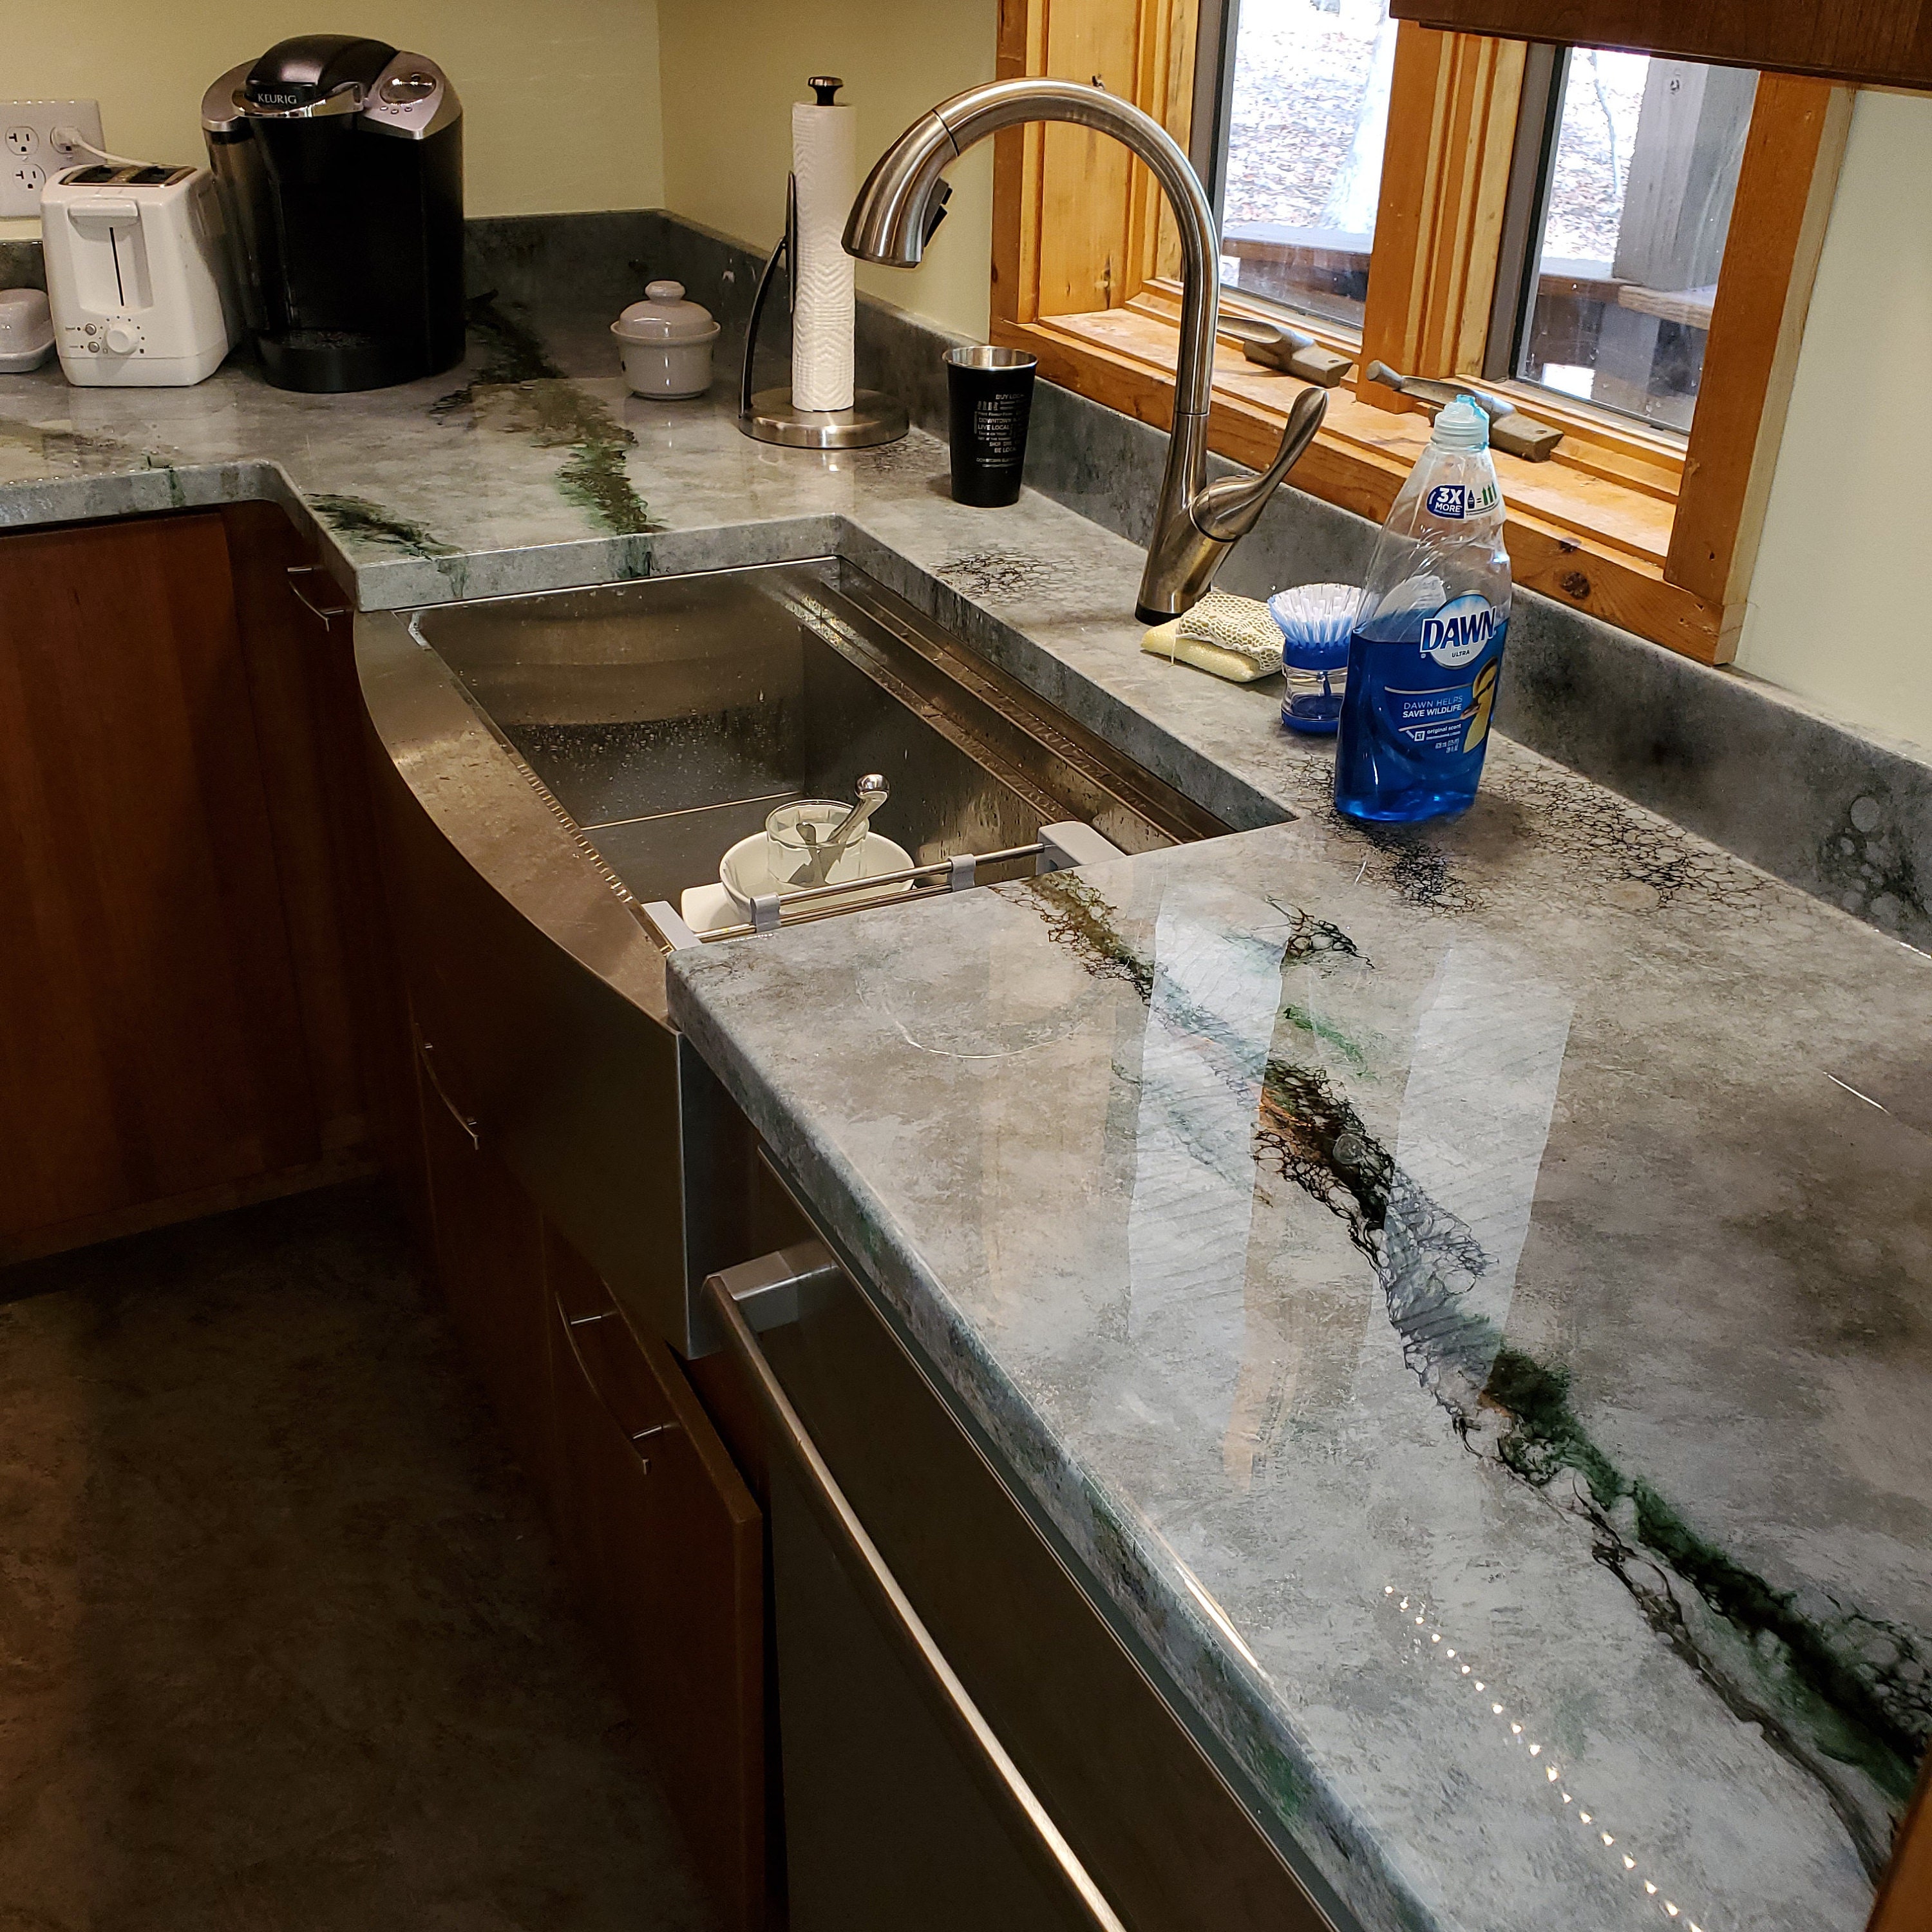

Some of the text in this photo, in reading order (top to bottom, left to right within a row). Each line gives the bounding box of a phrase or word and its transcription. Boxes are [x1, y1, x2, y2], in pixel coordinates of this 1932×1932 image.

[258, 93, 297, 104] KEURIG
[1437, 487, 1463, 504] 3X
[1435, 502, 1462, 513] MORE
[1420, 606, 1497, 652] DAWN
[1404, 696, 1463, 710] DAWN HELPS
[1426, 703, 1463, 716] WILDLIFE
[1426, 726, 1448, 734] original
